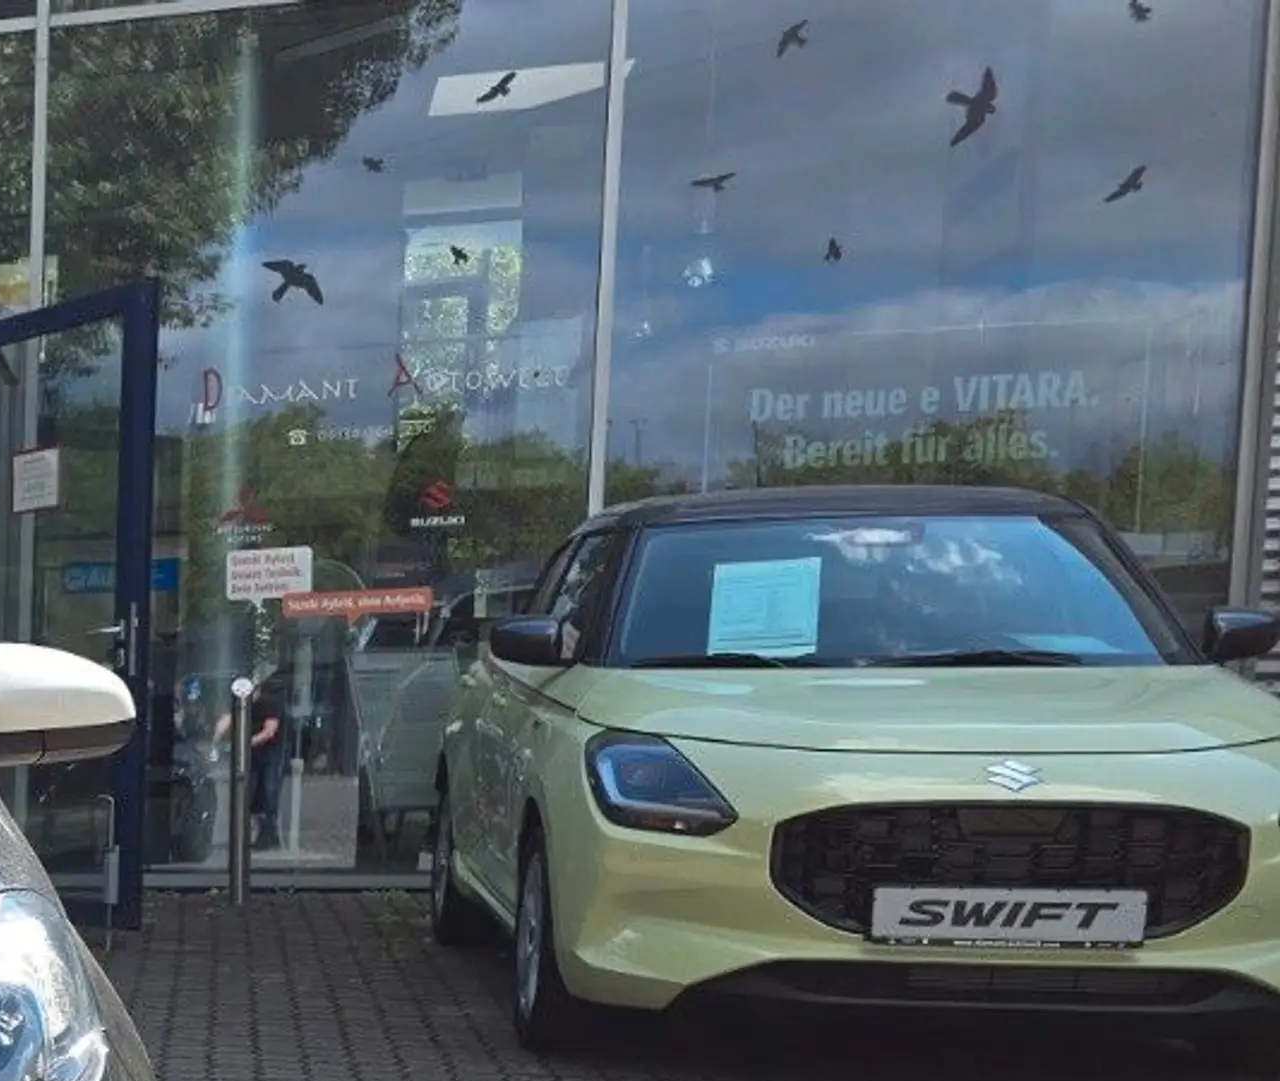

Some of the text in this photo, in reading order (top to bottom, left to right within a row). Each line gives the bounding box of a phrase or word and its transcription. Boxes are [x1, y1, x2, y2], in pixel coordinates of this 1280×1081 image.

[749, 370, 1100, 421] Der neue e VITARA.
[782, 422, 1059, 470] Bereit für alles.
[898, 899, 1120, 930] SWIFT
